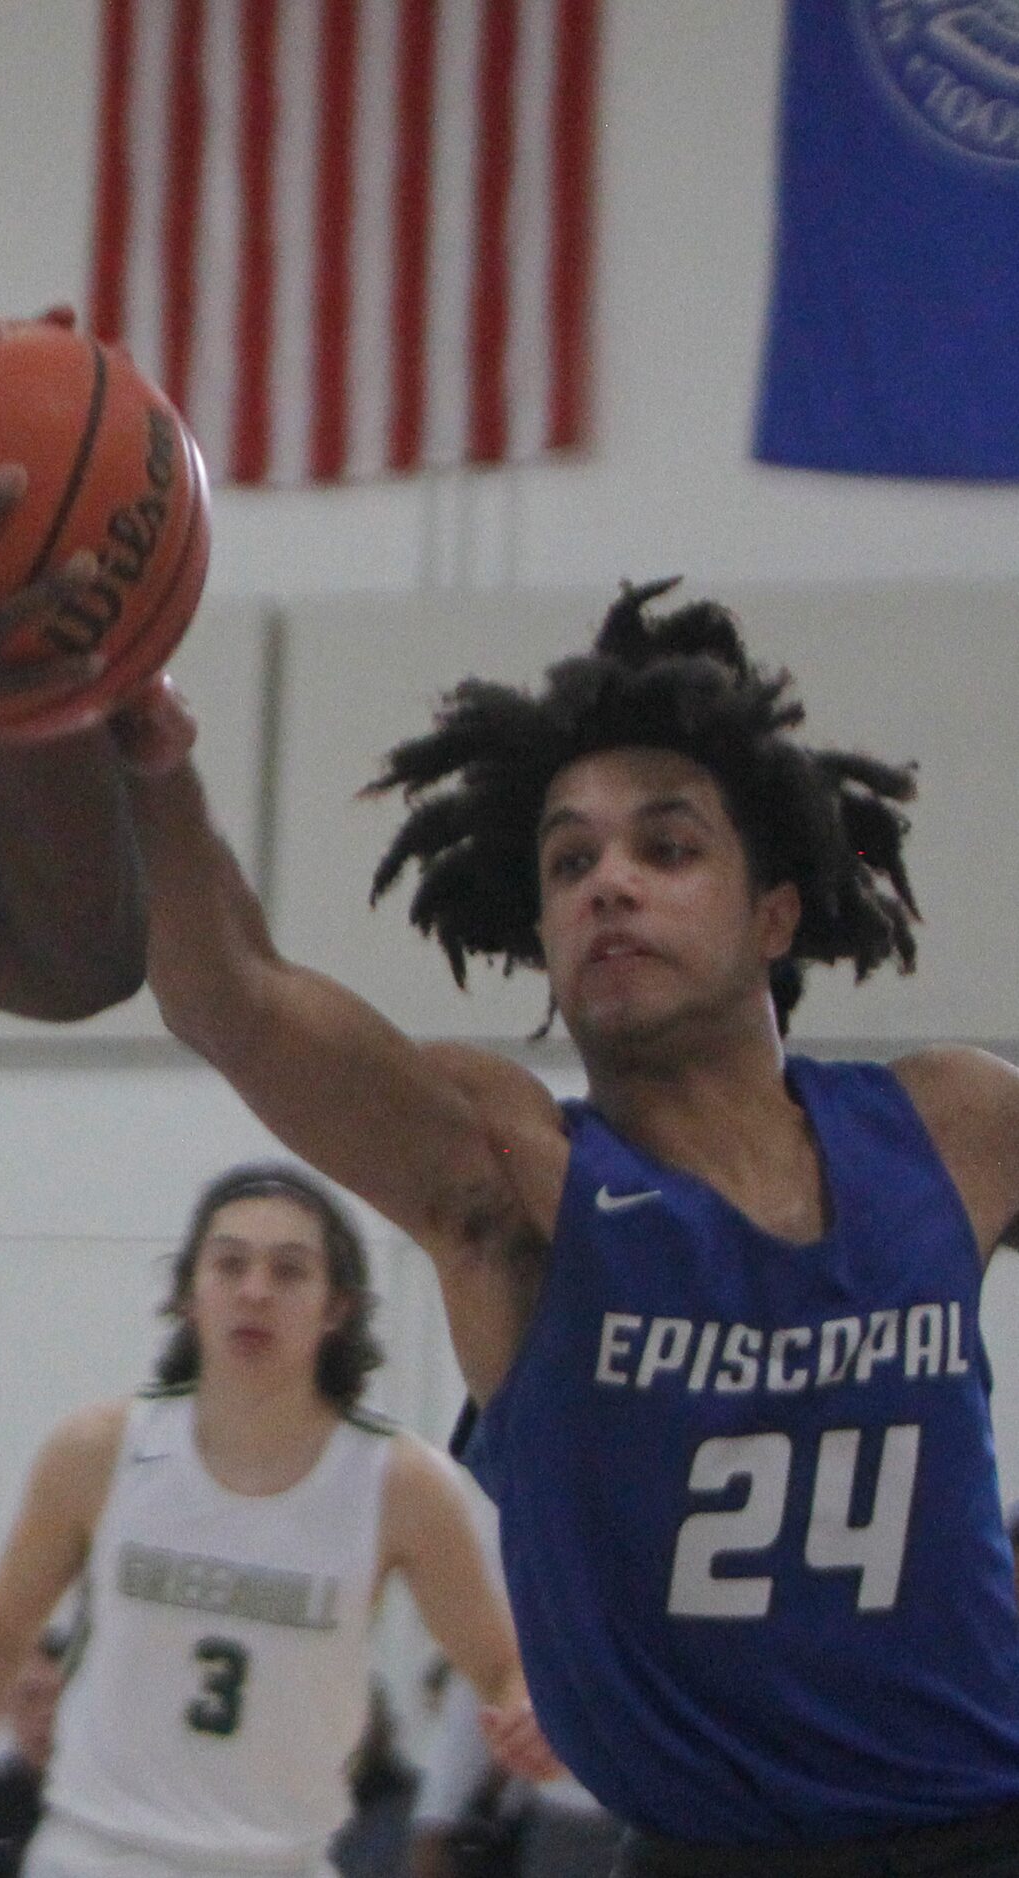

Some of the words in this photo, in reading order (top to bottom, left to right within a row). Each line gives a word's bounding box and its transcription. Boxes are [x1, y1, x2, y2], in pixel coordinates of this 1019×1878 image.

[594, 1301, 970, 1392] EPISCOPAL
[666, 1423, 922, 1618] 24
[185, 1634, 249, 1737] 3
